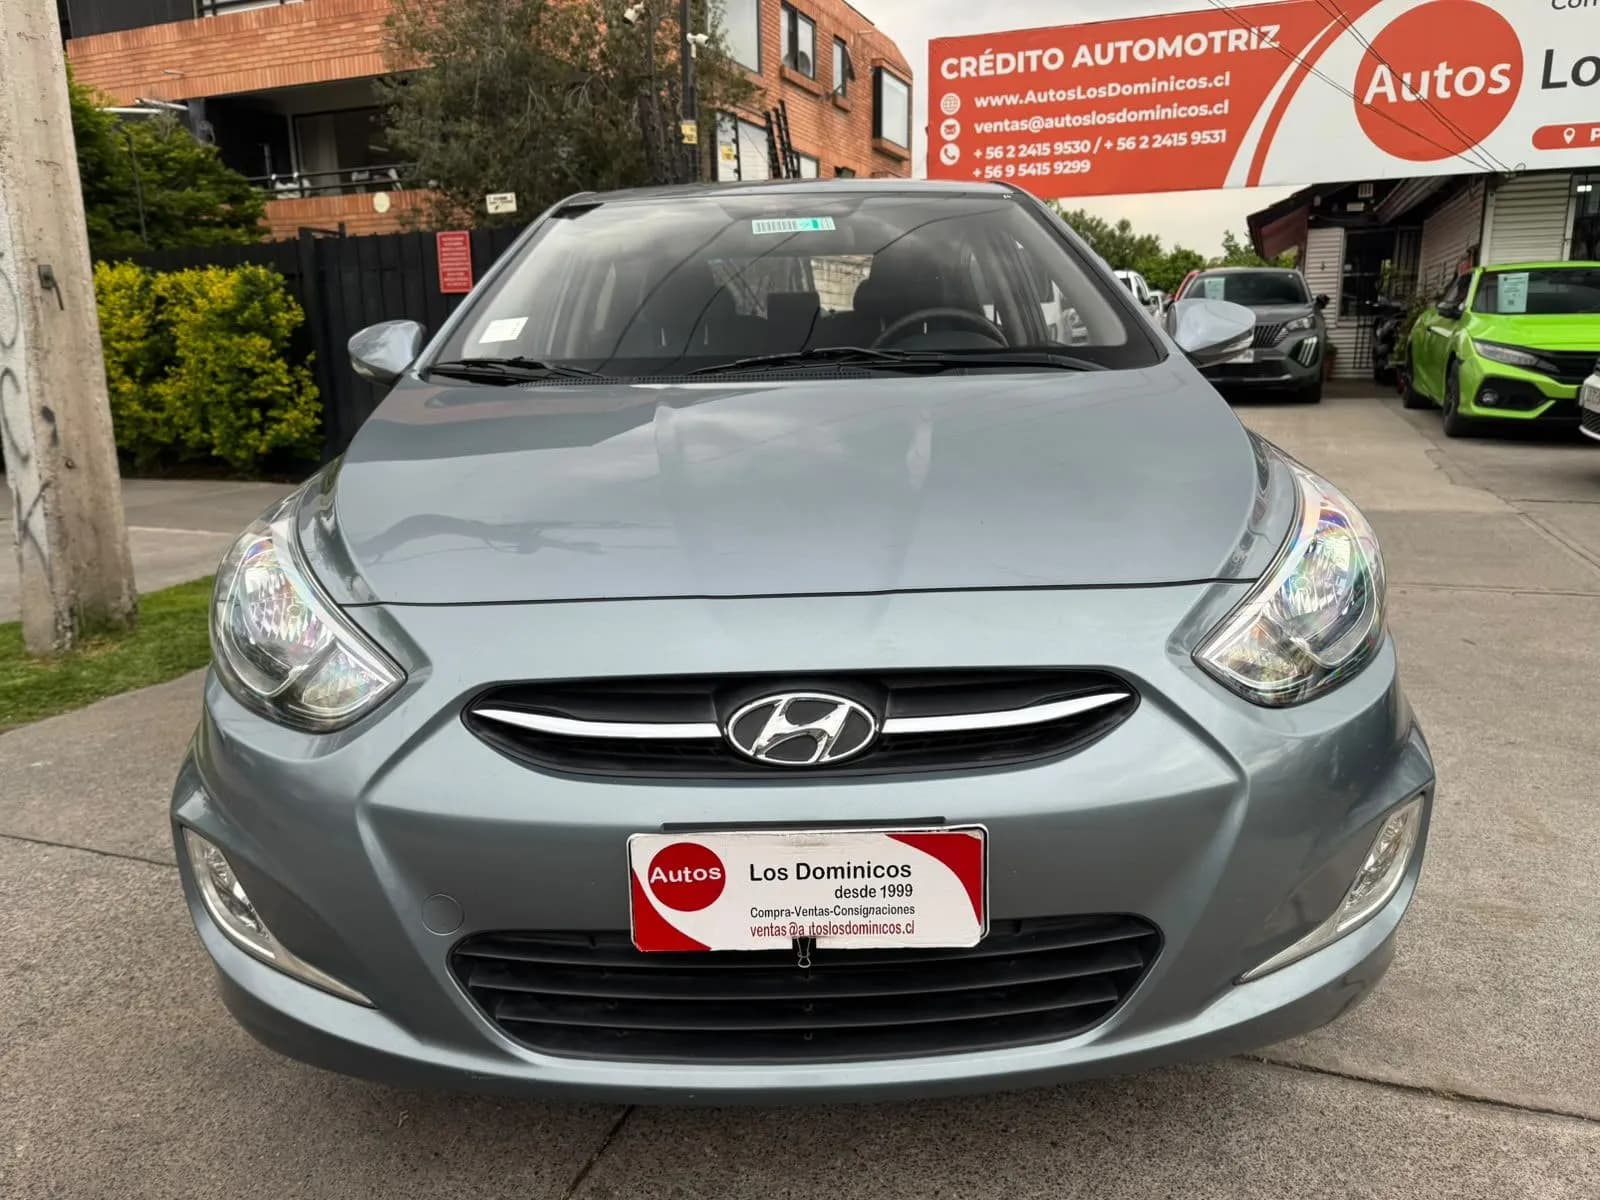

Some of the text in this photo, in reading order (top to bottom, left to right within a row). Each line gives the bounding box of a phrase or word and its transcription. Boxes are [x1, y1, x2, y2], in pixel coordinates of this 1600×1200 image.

[940, 24, 1281, 80] CRÉDITO AUTOMOTRIZ
[974, 70, 1231, 109] www.AutosLosDominicos.cl
[1362, 60, 1512, 105] Autos
[974, 99, 1230, 134] ventas@autoslosdominicos.cl
[985, 146, 1004, 160] 56
[1006, 145, 1016, 159] 2
[1018, 142, 1051, 158] 2415
[1053, 139, 1091, 156] 9530
[1116, 136, 1137, 152] 56
[1138, 135, 1150, 150] 2
[1151, 131, 1188, 149] 2415
[1190, 128, 1227, 146] 9531
[983, 165, 1003, 179] 56
[1005, 164, 1016, 178] 9
[1018, 161, 1051, 177] 5415
[1053, 159, 1092, 175] 9299
[649, 866, 723, 884] Autos
[749, 861, 912, 881] Los Dominicos
[834, 883, 914, 899] desde 1999
[750, 903, 916, 920] Compra-Ventas-Consignaciones
